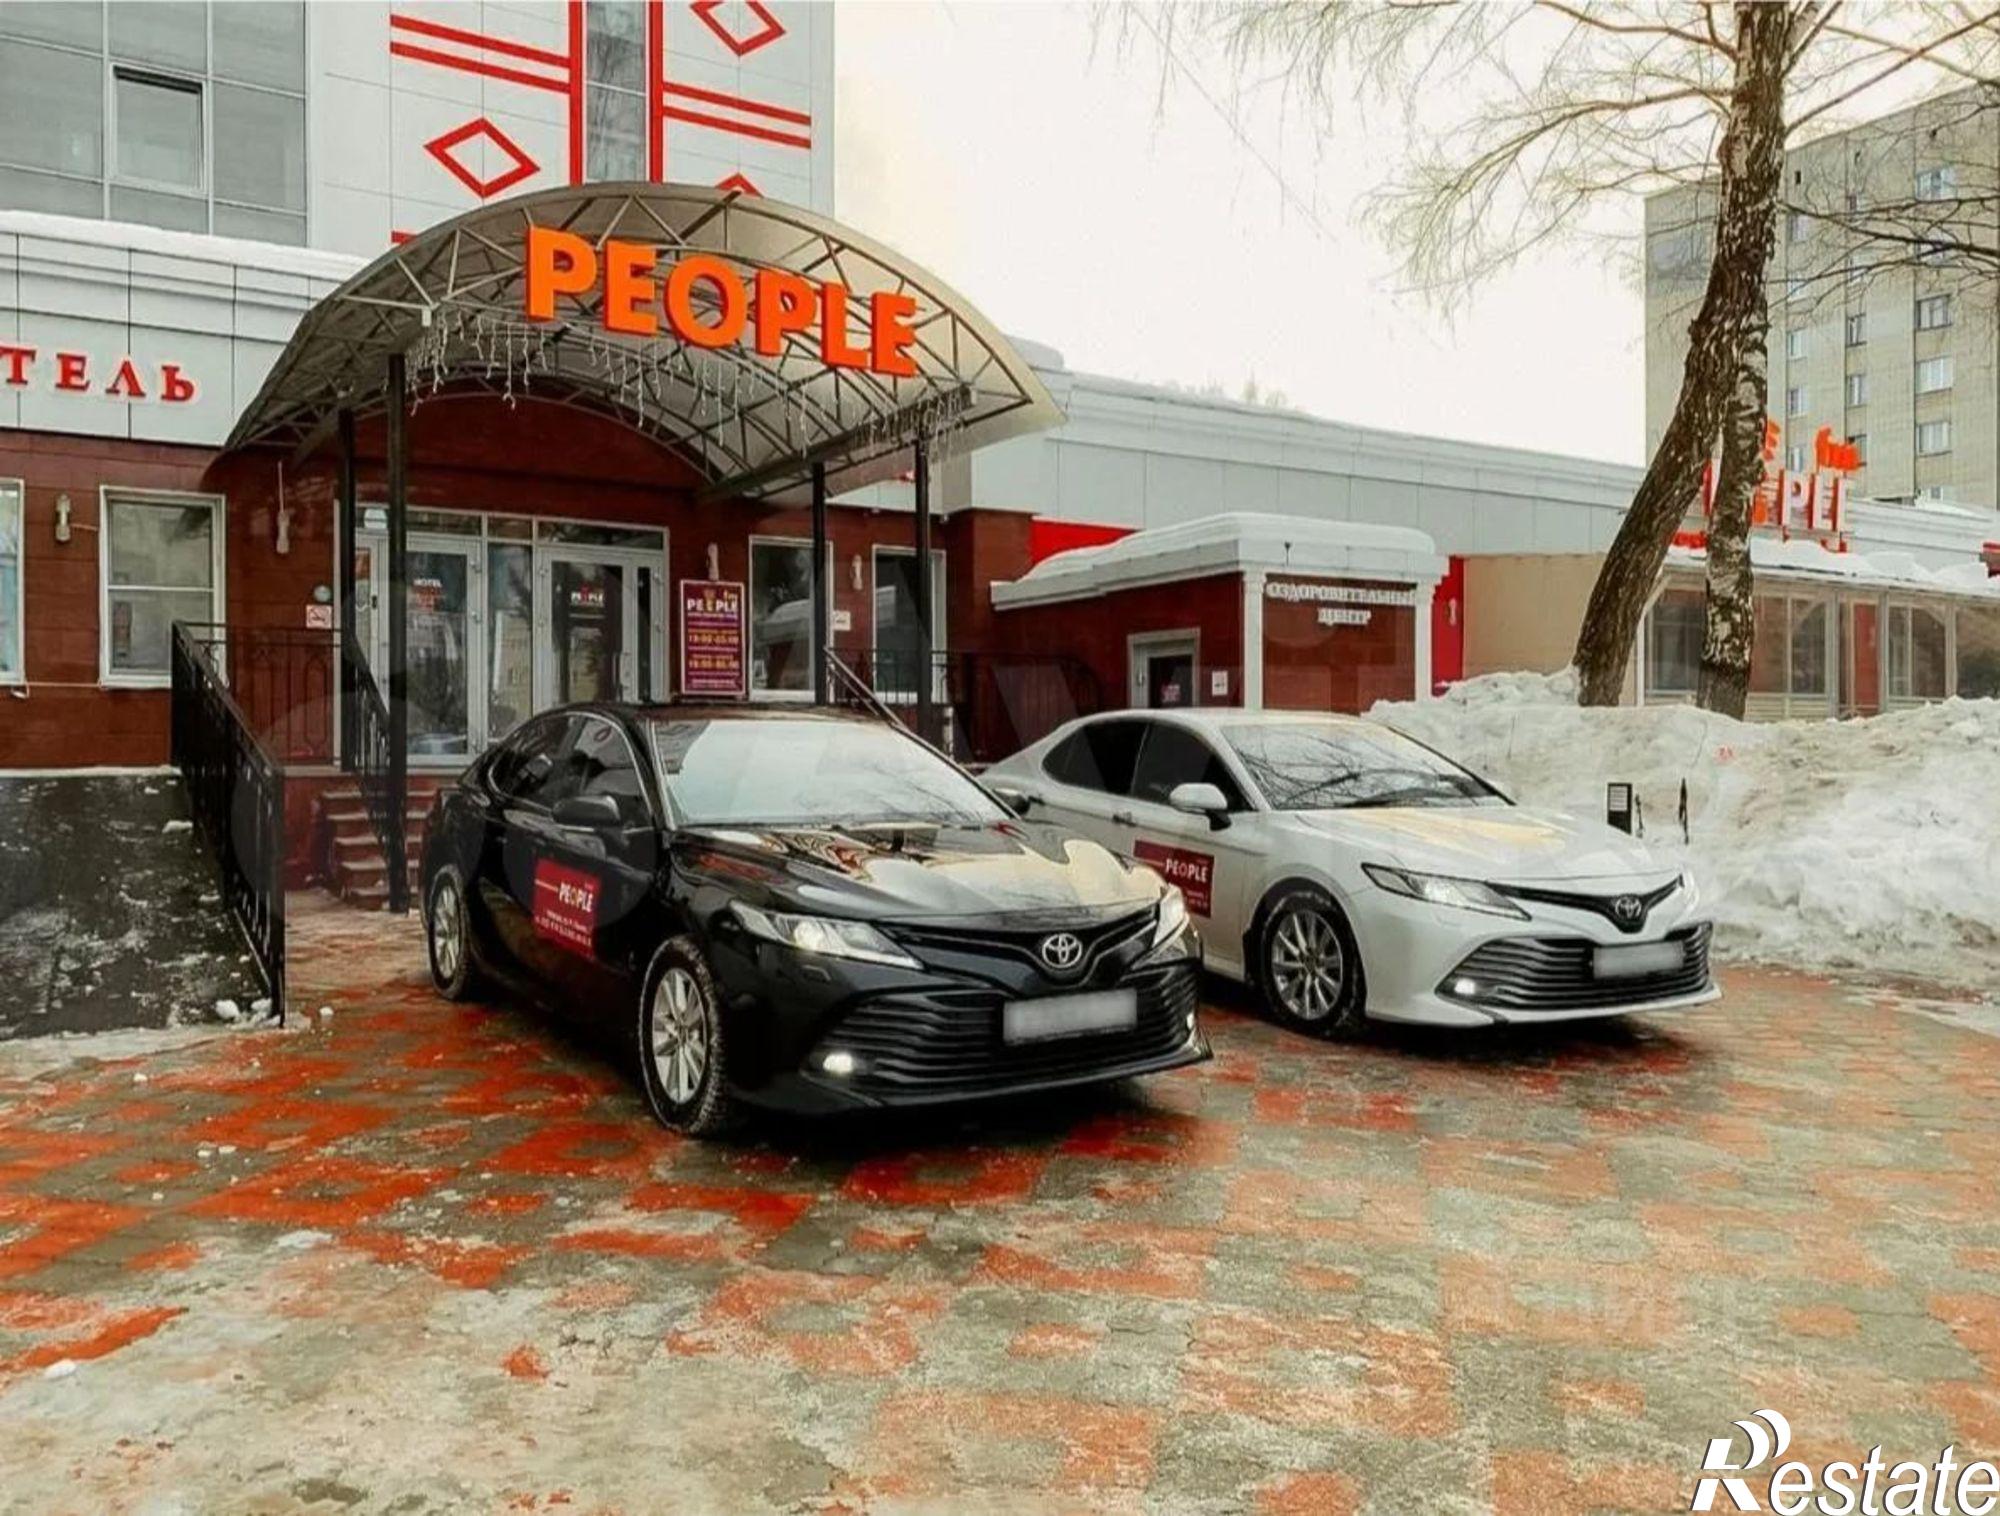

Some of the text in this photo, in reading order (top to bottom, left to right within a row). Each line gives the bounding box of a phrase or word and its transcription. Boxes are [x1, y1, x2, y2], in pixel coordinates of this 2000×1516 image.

[525, 223, 919, 378] PEOPLE
[0, 345, 195, 401] ТЕЛЬ
[1318, 608, 1371, 625] ЦЕНТР
[1165, 858, 1209, 883] PEOPLE
[559, 882, 594, 912] PEOPLE
